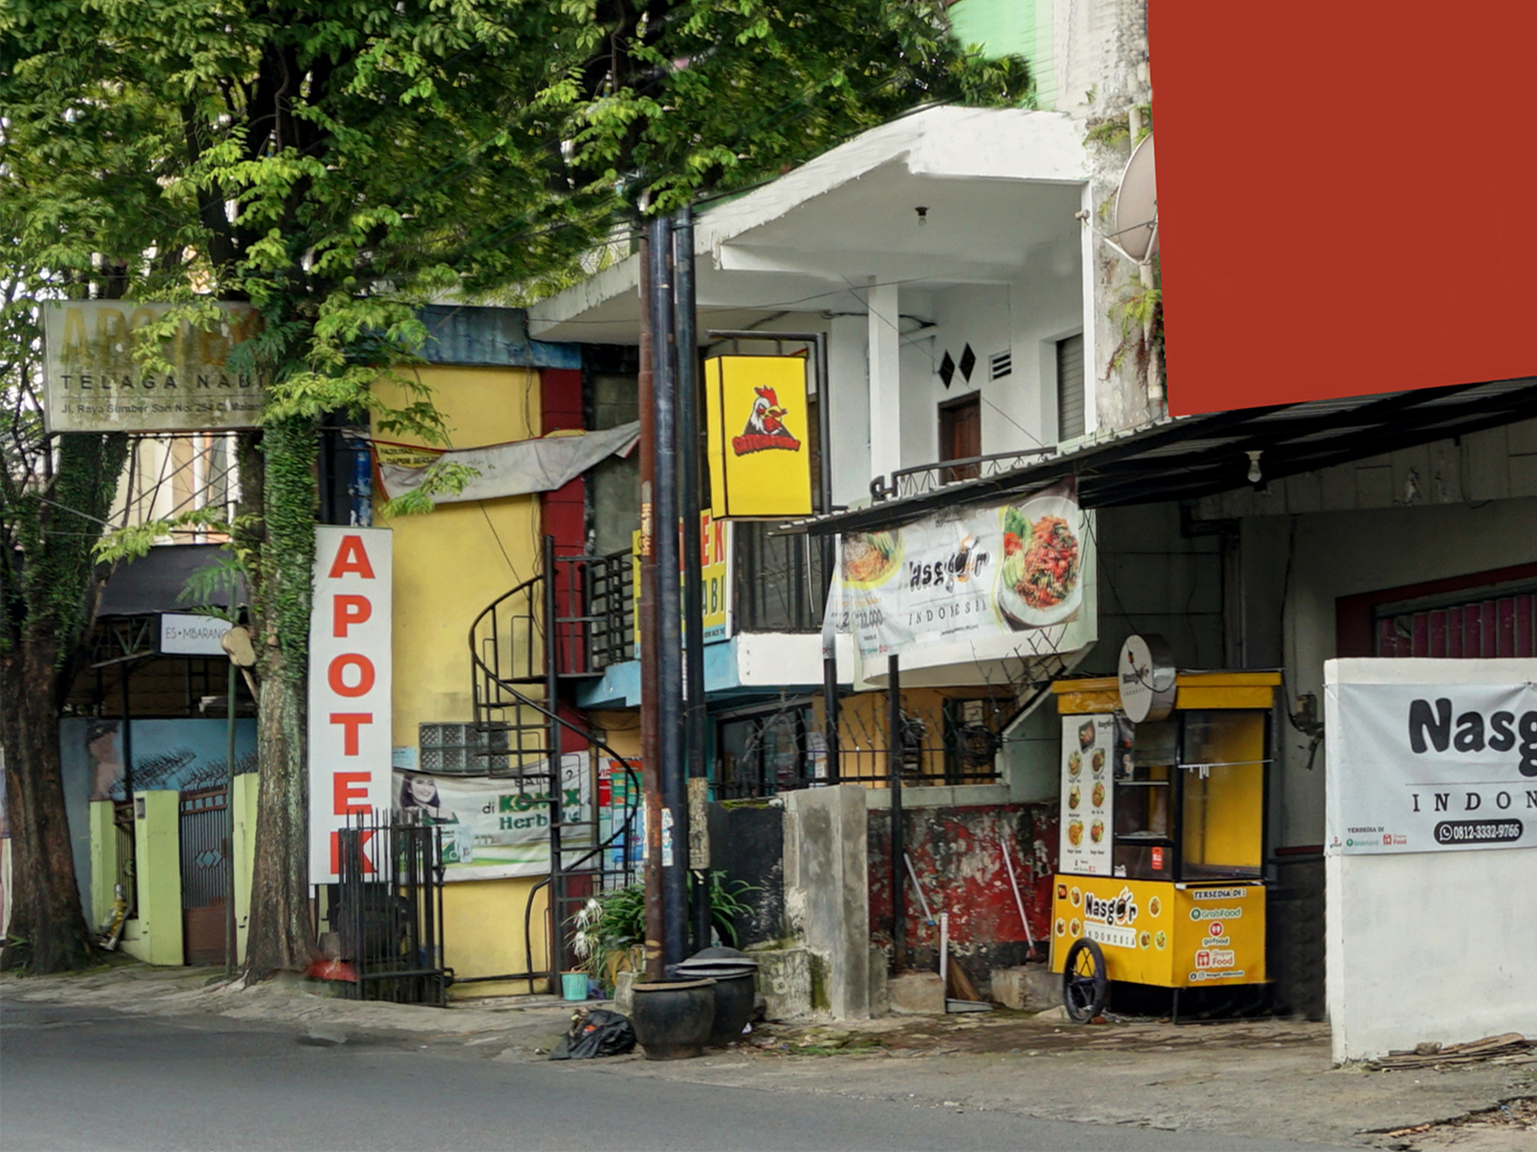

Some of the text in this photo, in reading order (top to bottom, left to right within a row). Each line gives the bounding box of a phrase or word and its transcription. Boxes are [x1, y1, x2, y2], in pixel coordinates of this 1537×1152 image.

[60, 374, 177, 390] TELAGA
[327, 534, 379, 875] APOTEK
[482, 799, 495, 814] di
[1194, 891, 1231, 899] TERSEDIA
[1085, 892, 1137, 925] Nasgor
[1212, 957, 1233, 965] Food
